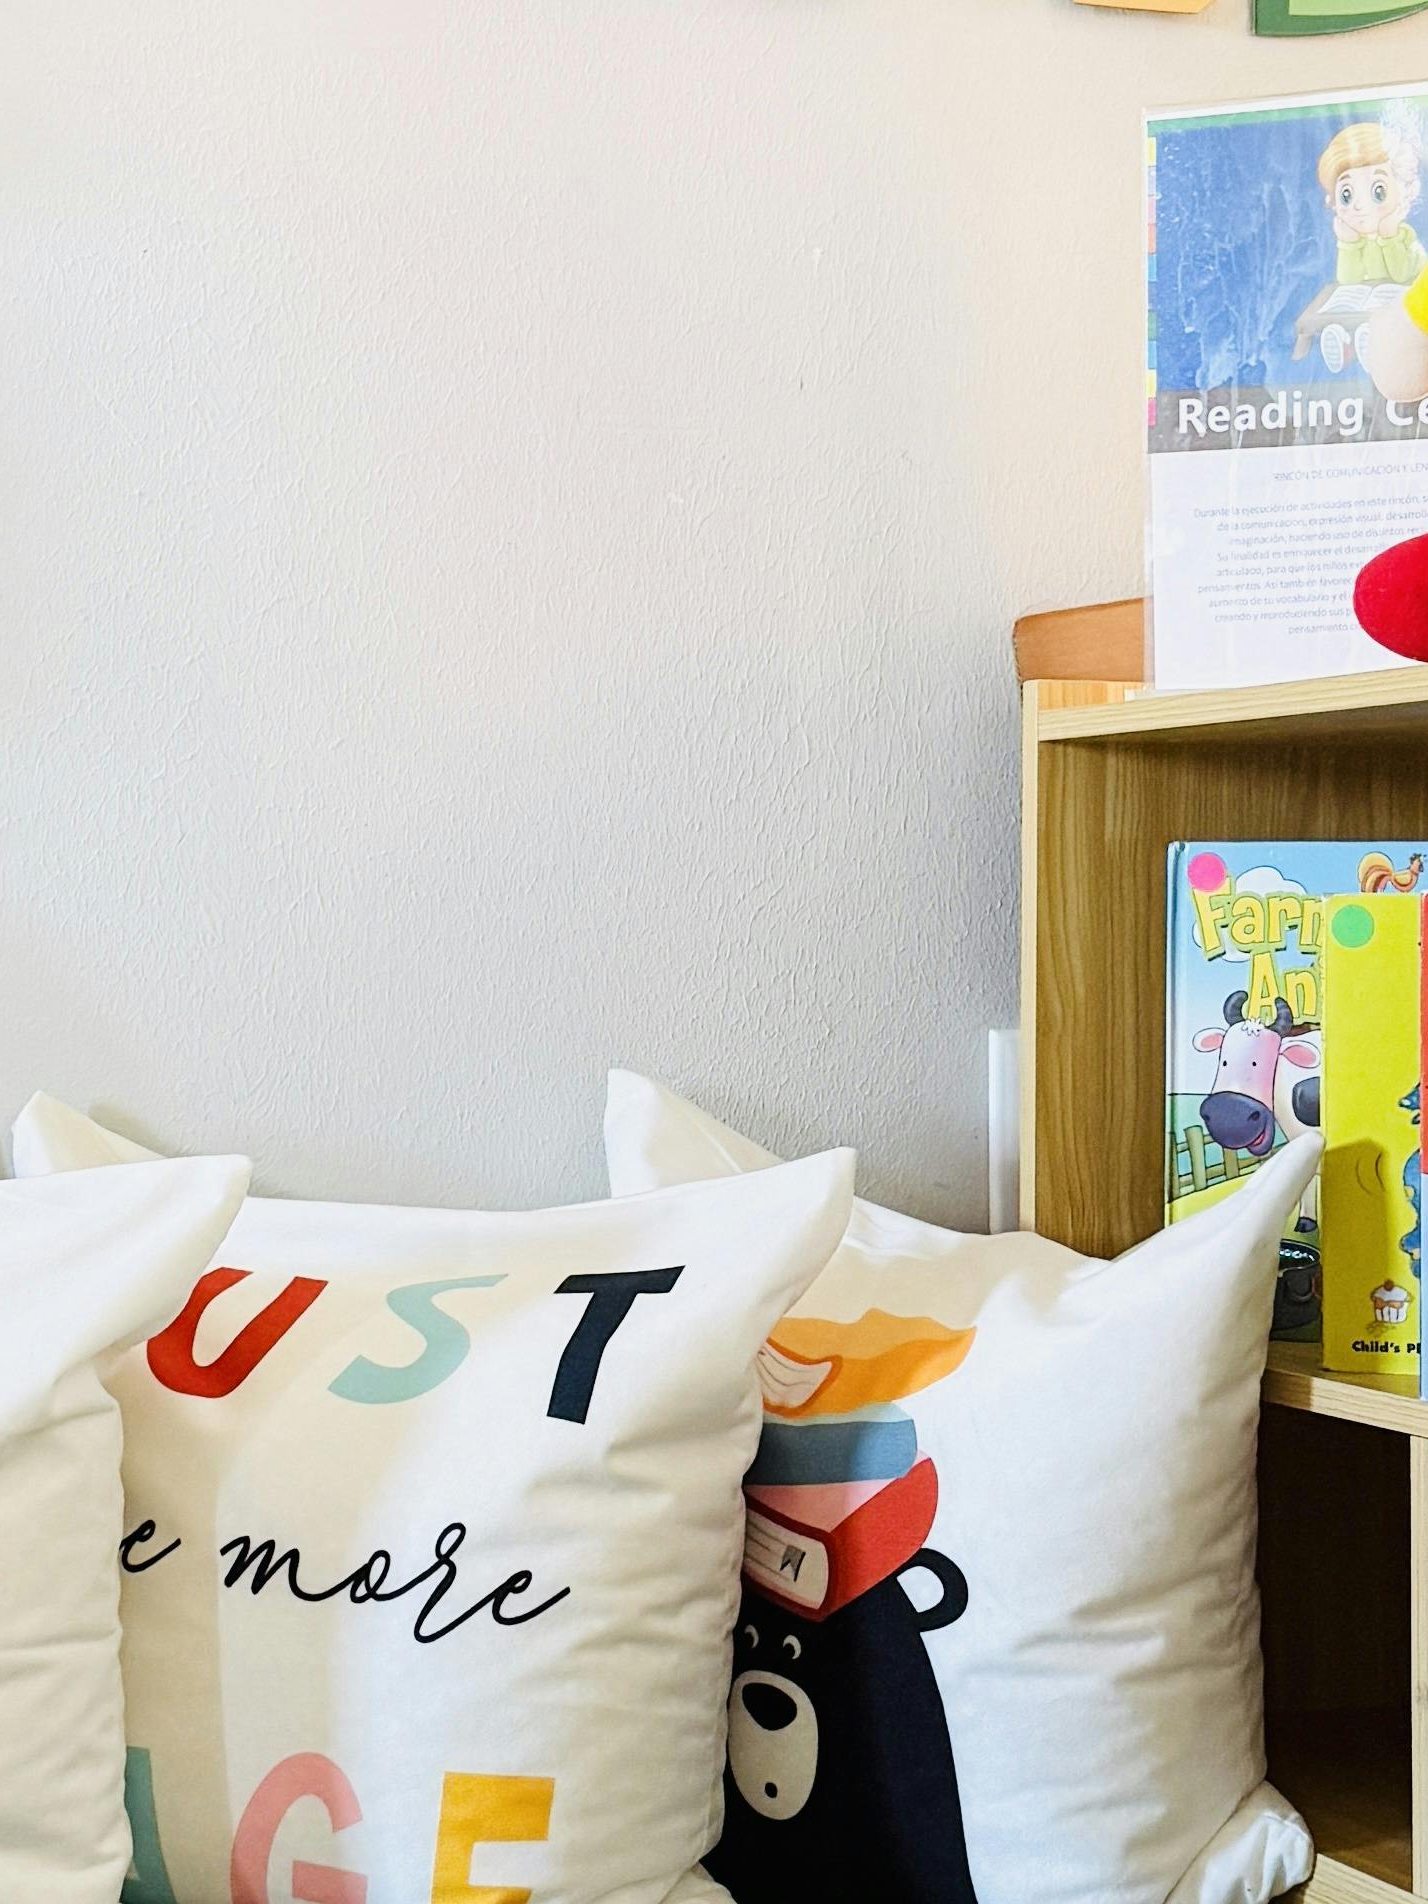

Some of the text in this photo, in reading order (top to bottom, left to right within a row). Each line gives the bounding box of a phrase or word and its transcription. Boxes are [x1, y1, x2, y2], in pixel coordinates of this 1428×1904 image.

[1177, 391, 1364, 437] Reading
[1352, 1341, 1400, 1353] Child's
[220, 1521, 571, 1643] more
